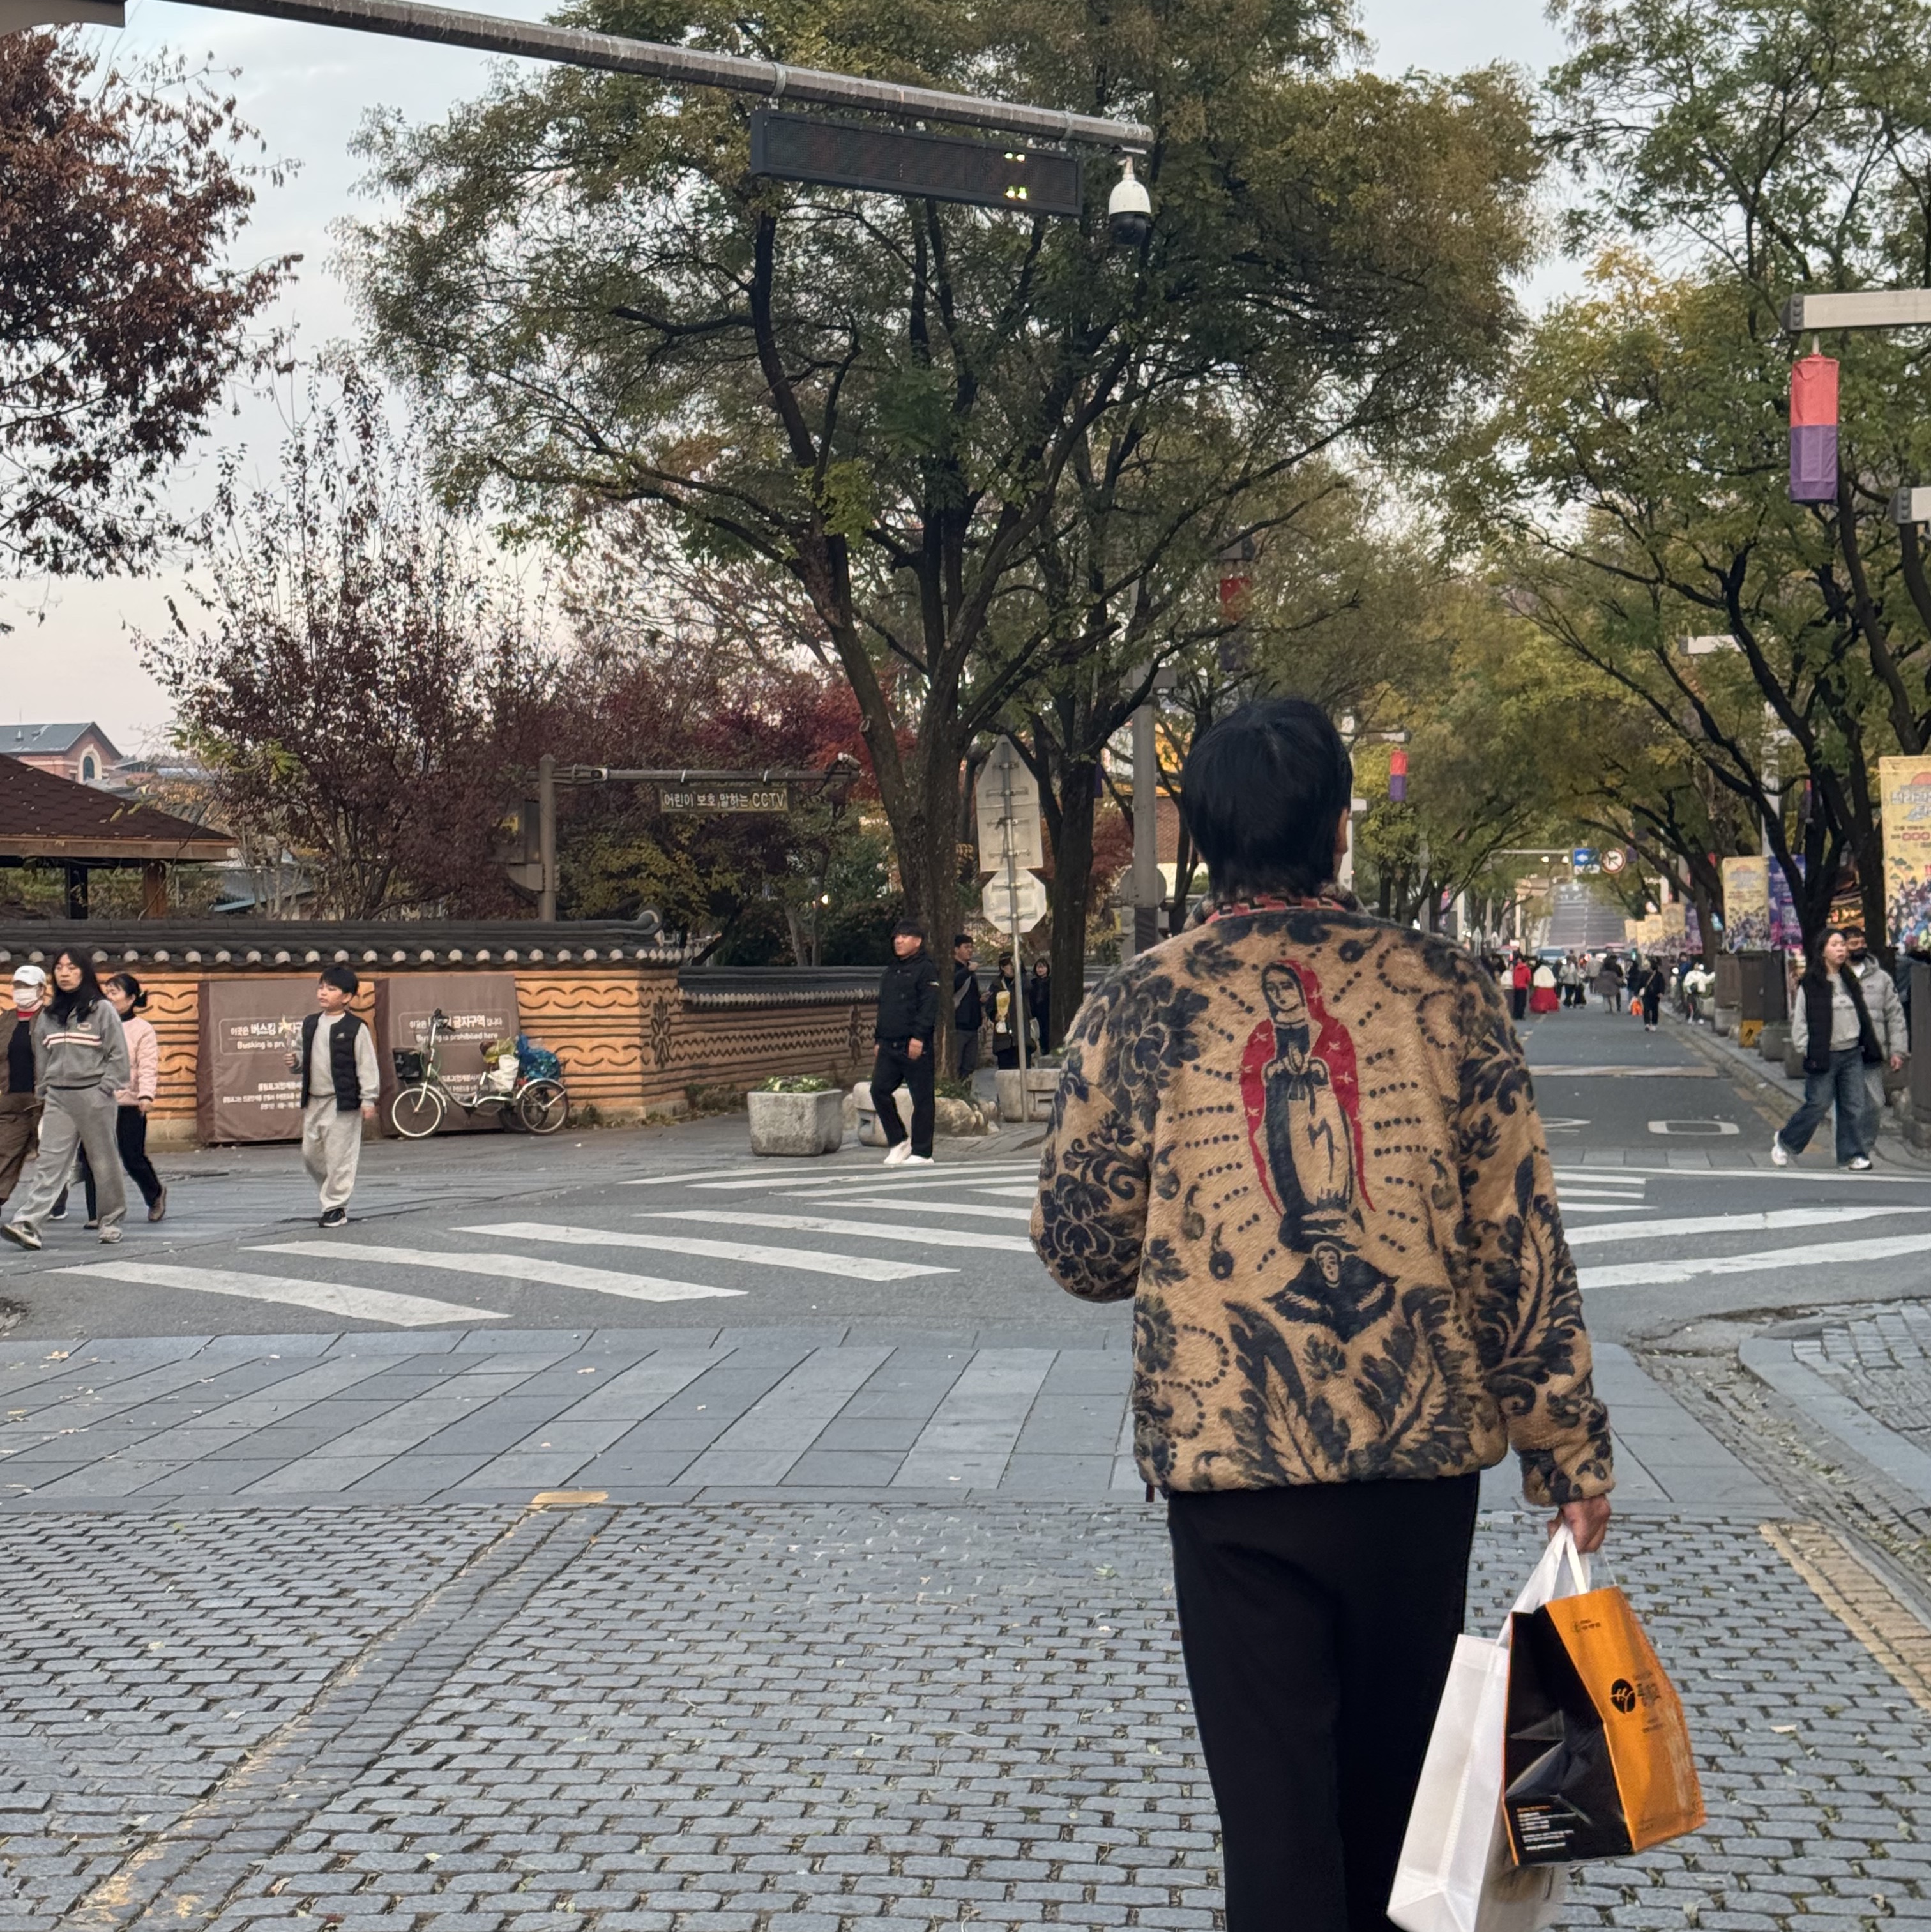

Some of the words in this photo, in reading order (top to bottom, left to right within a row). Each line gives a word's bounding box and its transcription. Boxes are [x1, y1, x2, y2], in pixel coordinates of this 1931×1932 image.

[664, 793, 693, 808] 어린이
[697, 793, 716, 807] 보호
[719, 793, 748, 808] 말하는
[752, 793, 784, 807] CCTV
[453, 1015, 485, 1028] 금지구역
[230, 1026, 249, 1036] 이곳은
[250, 1022, 276, 1035] 버스킹
[237, 1040, 266, 1050] Busking
